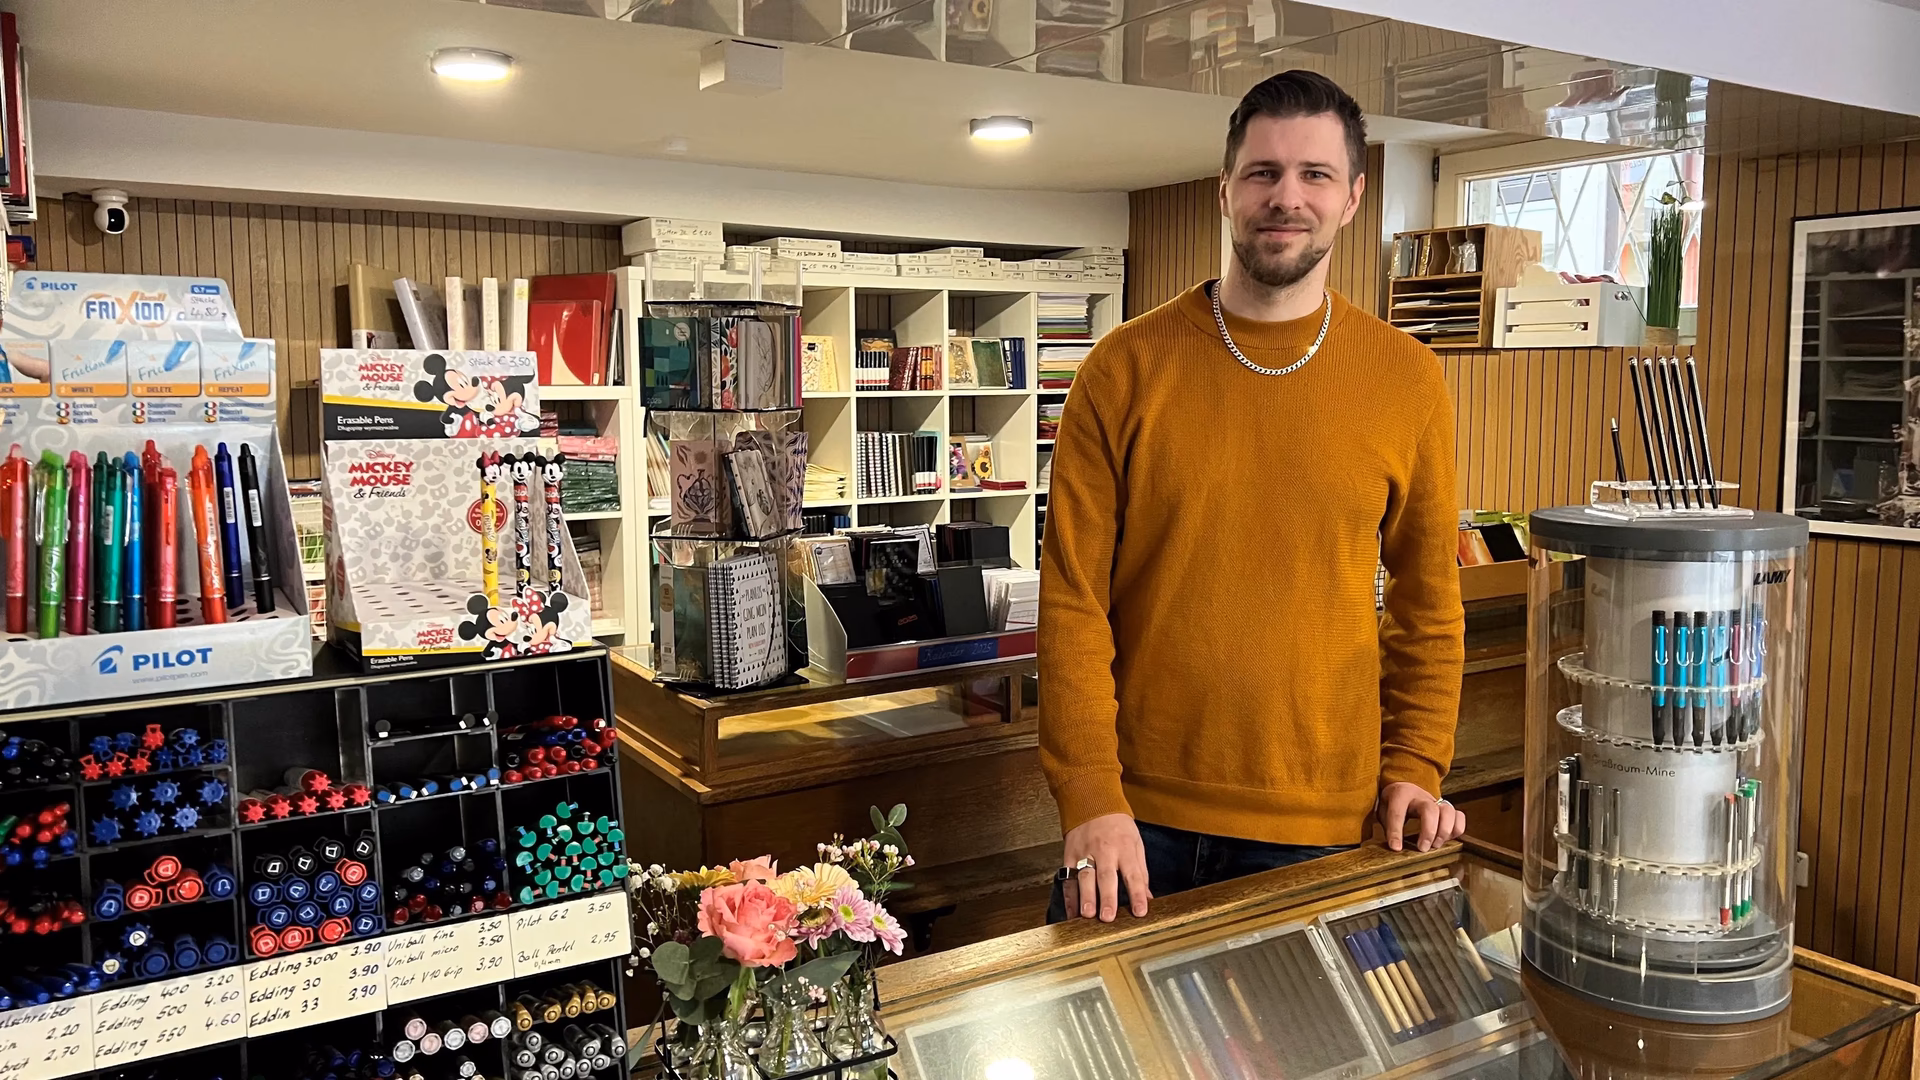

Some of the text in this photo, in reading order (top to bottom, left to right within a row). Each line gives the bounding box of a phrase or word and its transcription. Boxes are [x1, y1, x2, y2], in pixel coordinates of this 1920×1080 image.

[41, 282, 78, 291] PILOT
[358, 363, 405, 372] MICKEY
[360, 373, 403, 382] MOUSE
[362, 383, 372, 391] &
[337, 415, 394, 424] Erasable Pens
[348, 461, 414, 474] MICKEY
[349, 474, 411, 487] MOUSE
[353, 486, 406, 499] & Friends
[1753, 569, 1791, 586] LAMY
[416, 628, 455, 638] MICKEY
[418, 636, 454, 646] MOUSE
[132, 647, 213, 672] PILOT
[370, 656, 398, 665] Erasable
[922, 646, 964, 662] Kalender
[516, 916, 541, 931] Pilot
[388, 934, 426, 953] Uniball
[432, 929, 455, 942] fine
[386, 951, 424, 968] Uniball
[430, 944, 459, 958] micro
[517, 948, 540, 964] Ball
[545, 940, 576, 956] Pentel
[249, 941, 382, 982] Edding 3000 3.90
[249, 964, 379, 1004] Edding 30 3.90
[389, 972, 416, 990] Pilot
[97, 974, 235, 1015] Edding 400 3.20
[95, 990, 240, 1035] Edding 500 4.60
[249, 984, 377, 1028] Eddin 33 3.90
[95, 1012, 241, 1058] Edding 550 4.60
